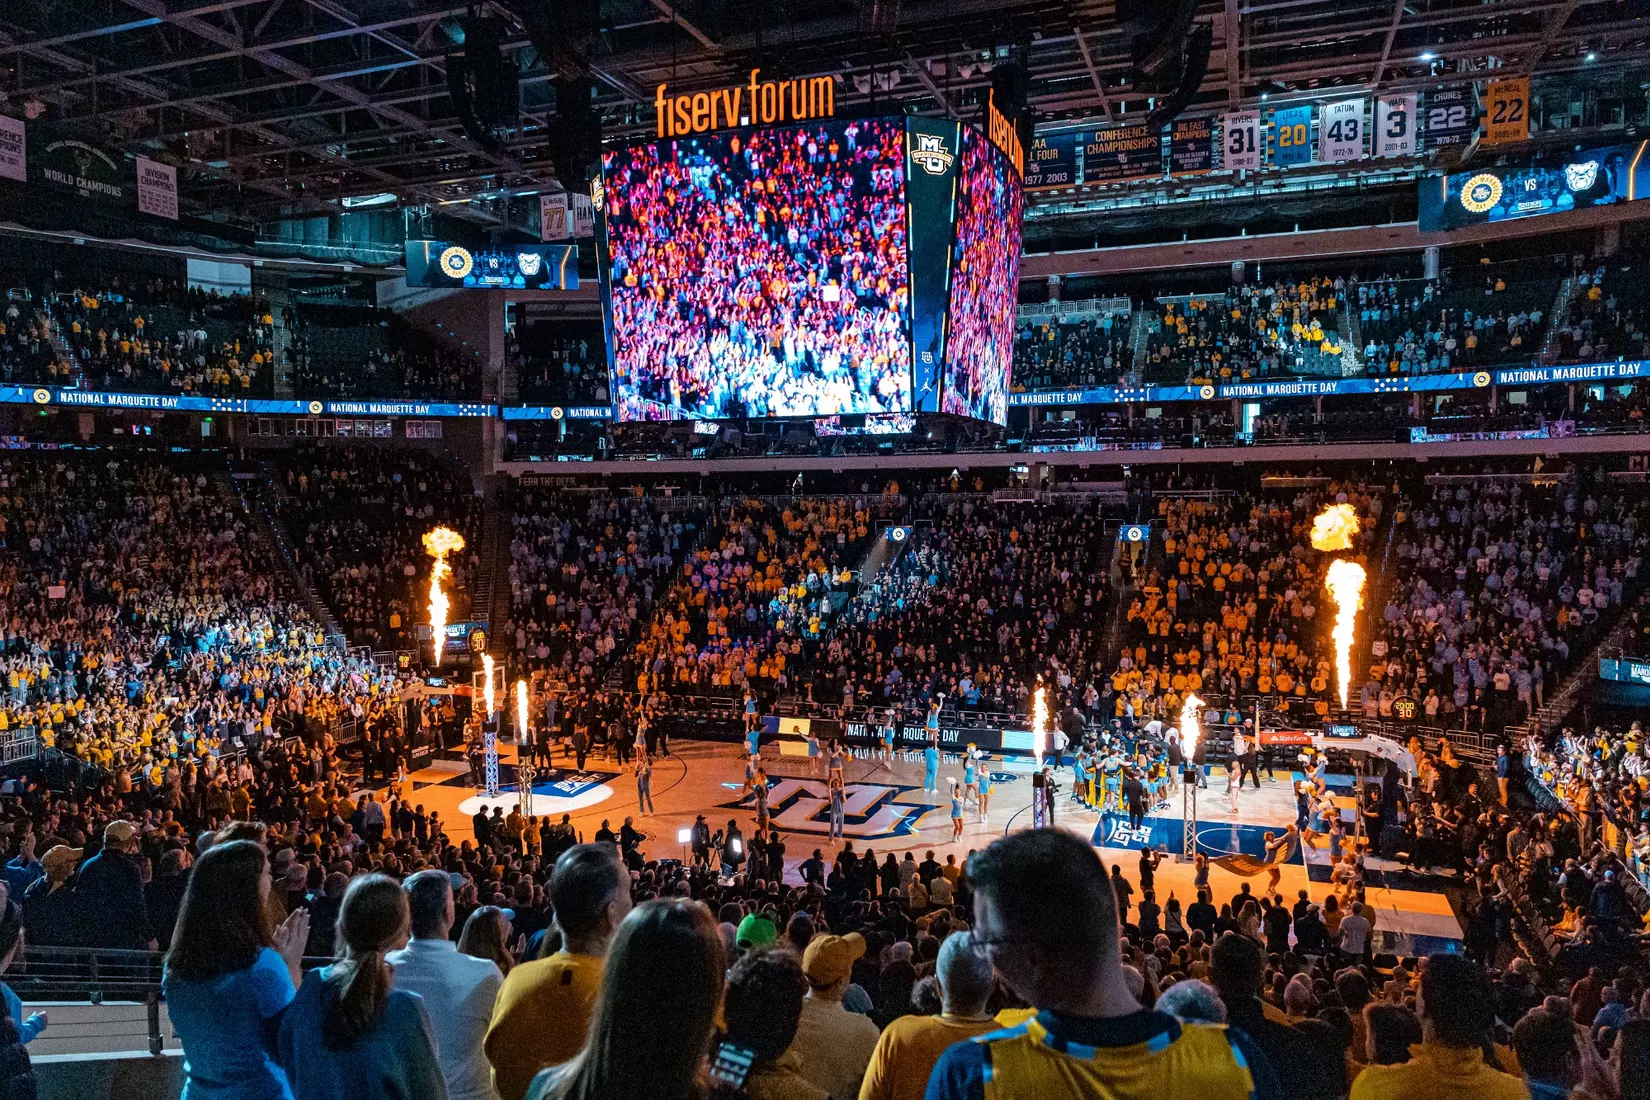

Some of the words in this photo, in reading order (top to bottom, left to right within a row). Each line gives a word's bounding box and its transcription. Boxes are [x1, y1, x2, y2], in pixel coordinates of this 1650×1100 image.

[747, 68, 834, 124] forum
[1434, 91, 1461, 102] CHONES
[1282, 110, 1303, 119] LUCAS
[1334, 104, 1354, 114] TATUM
[1492, 98, 1523, 124] 22
[1231, 115, 1252, 125] RIVERS
[1386, 110, 1406, 138] 3
[1429, 106, 1466, 130] 22
[1178, 123, 1188, 131] BIG
[1190, 121, 1205, 130] EAST
[1327, 119, 1358, 142] 43
[1095, 126, 1148, 142] CONFERENCE
[1229, 126, 1255, 154] 31
[1279, 124, 1306, 147] 20
[1436, 136, 1460, 144] 1970-72
[1087, 137, 1158, 155] CHAMPIONSHIPS
[1385, 143, 1407, 151] 2001-03
[1037, 149, 1058, 161] FOUR
[145, 168, 169, 181] DIVISION
[1024, 174, 1042, 185] 1977
[1047, 172, 1068, 183] 2003
[44, 168, 73, 185] WORLD
[76, 177, 121, 197] CHAMPIONS
[141, 175, 174, 192] CHAMPIONS
[1524, 178, 1536, 191] VS
[544, 207, 564, 230] 77
[488, 258, 498, 268] VS
[1500, 371, 1549, 383] NATIONAL
[1553, 365, 1615, 380] MARQUETTE
[1619, 363, 1640, 375] DAY
[1223, 384, 1262, 396] NATIONAL
[1267, 382, 1317, 395] MARQUETTE
[1320, 382, 1337, 393] DAY
[60, 392, 105, 404] NATIONAL
[108, 395, 159, 407] MARQUETTE
[162, 398, 178, 408] DAY
[1021, 393, 1064, 405] MARQUETTE
[1066, 393, 1082, 402] DAY
[330, 403, 367, 413] NATIONAL
[370, 403, 413, 414] MARQUETTE
[415, 404, 429, 415] DAY
[570, 407, 602, 417] NATIONAL
[519, 477, 538, 486] FEAR
[540, 477, 554, 486] THE
[556, 477, 576, 486] DEER
[474, 640, 484, 651] 30
[1396, 702, 1414, 710] 20:00
[1399, 710, 1411, 718] 30
[943, 730, 959, 743] DAY
